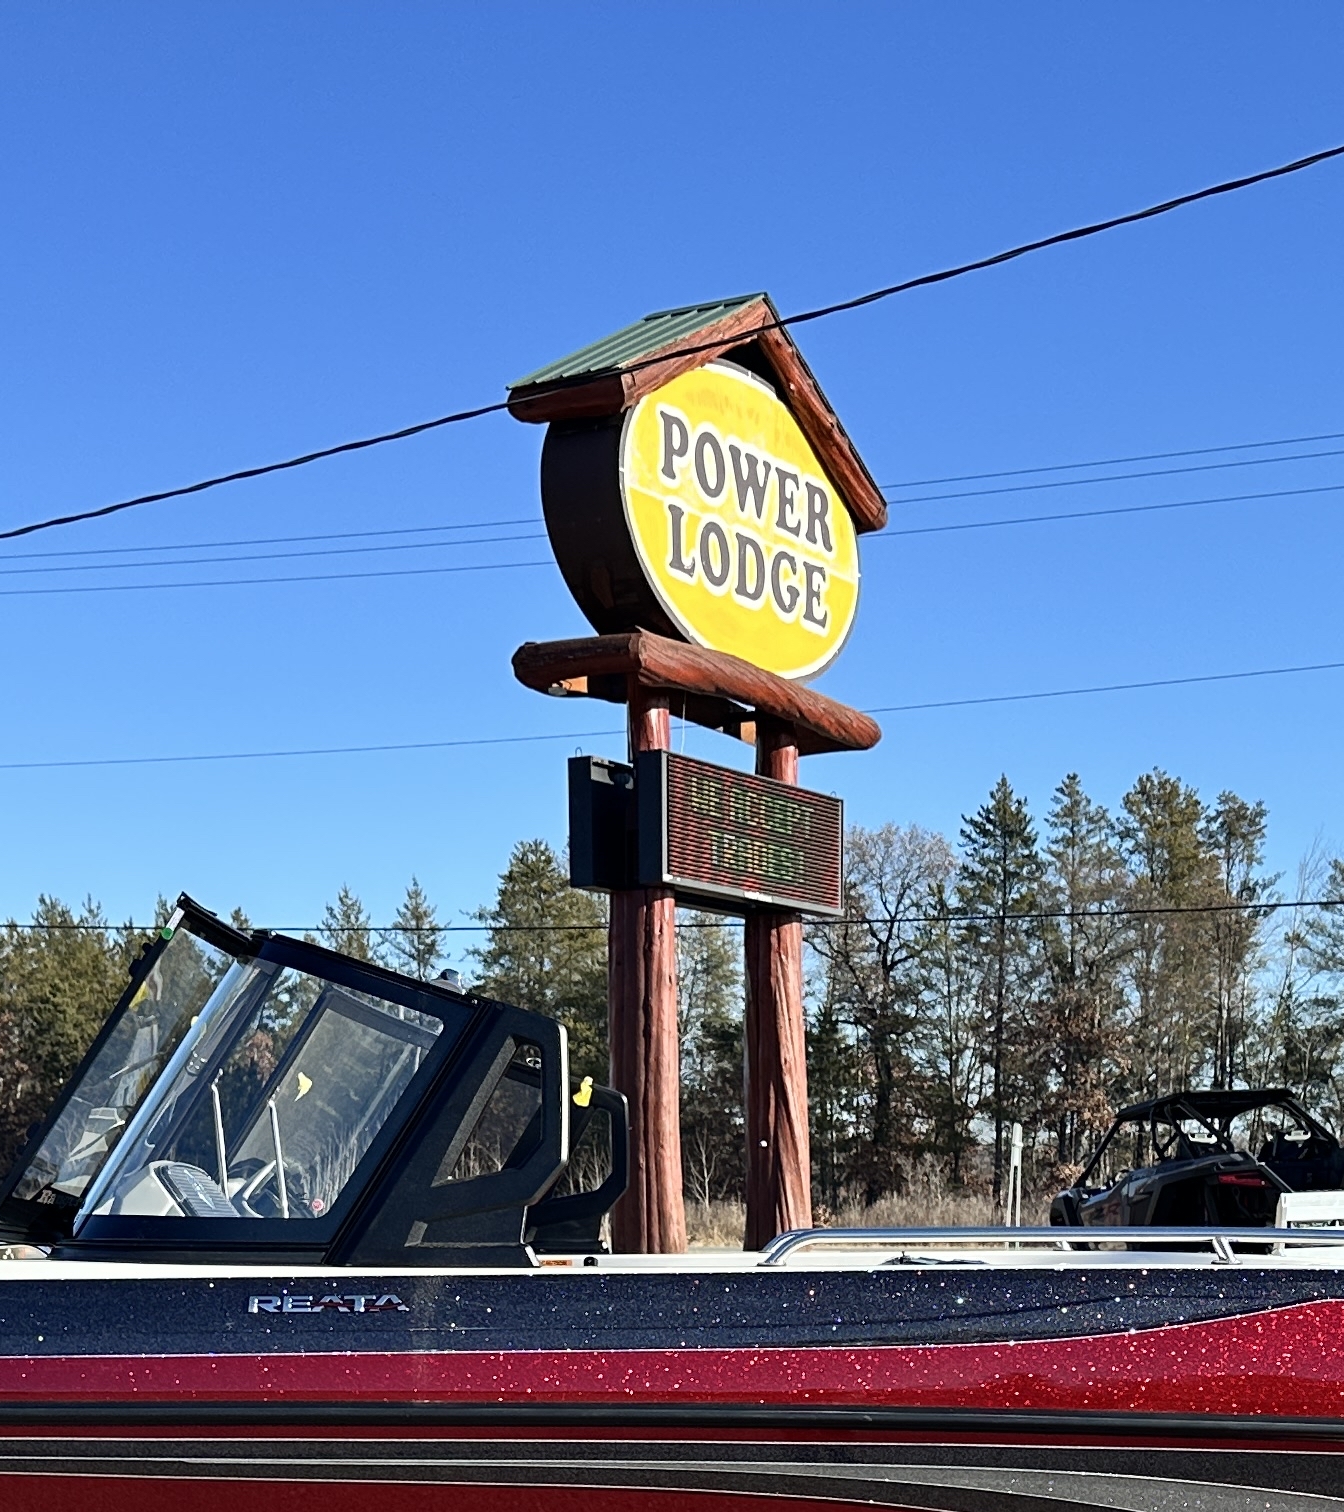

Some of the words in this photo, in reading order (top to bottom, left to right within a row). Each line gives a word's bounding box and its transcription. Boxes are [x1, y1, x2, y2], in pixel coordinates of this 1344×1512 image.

[660, 410, 833, 552] POWER
[668, 503, 828, 629] LODGE
[691, 776, 723, 818] WE
[729, 787, 815, 839] ACCEPT
[247, 1294, 410, 1313] REATA
